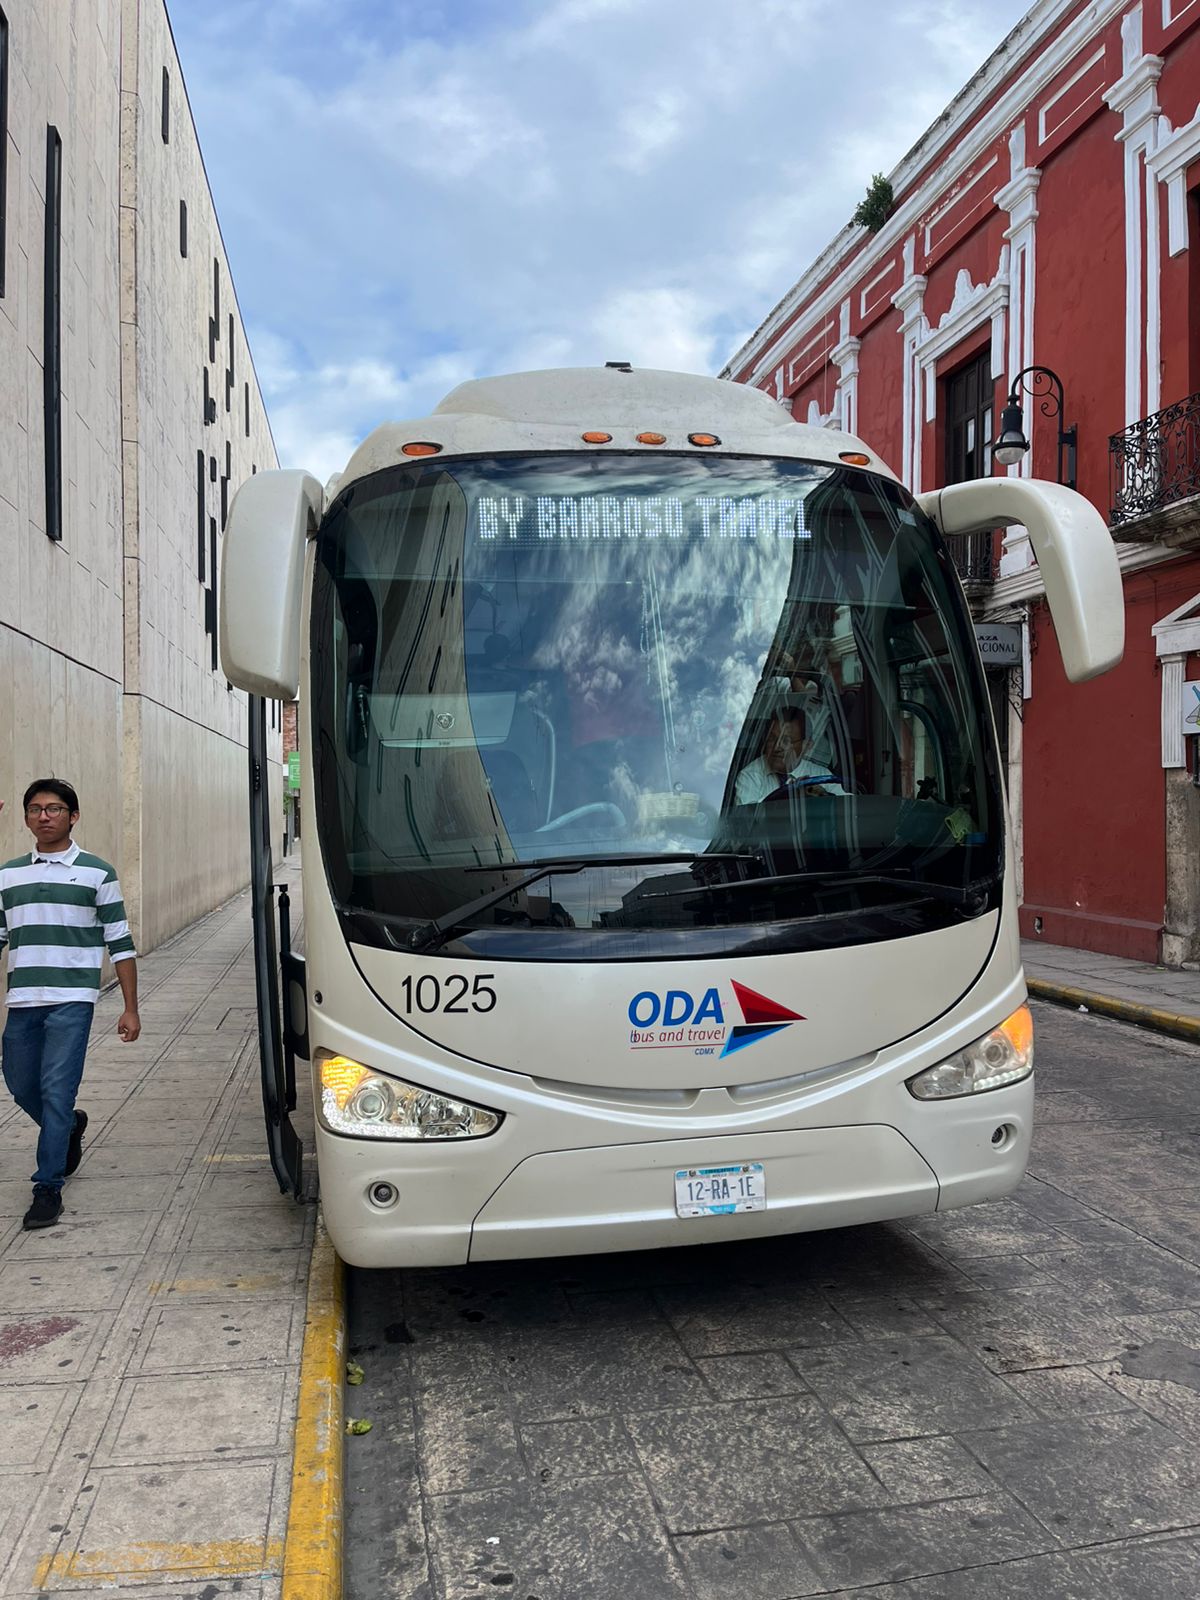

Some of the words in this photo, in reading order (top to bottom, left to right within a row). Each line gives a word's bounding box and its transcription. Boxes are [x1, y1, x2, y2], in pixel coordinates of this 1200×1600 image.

[478, 496, 524, 539] BY
[536, 496, 684, 538] BARROSO
[695, 496, 812, 538] TRAVEL
[401, 973, 497, 1014] 1025
[627, 987, 725, 1029] ODA
[630, 1029, 655, 1044] bus
[658, 1027, 685, 1042] and
[687, 1026, 726, 1041] travel
[694, 1047, 715, 1056] CDMX
[687, 1176, 756, 1201] 12-RA-1E
